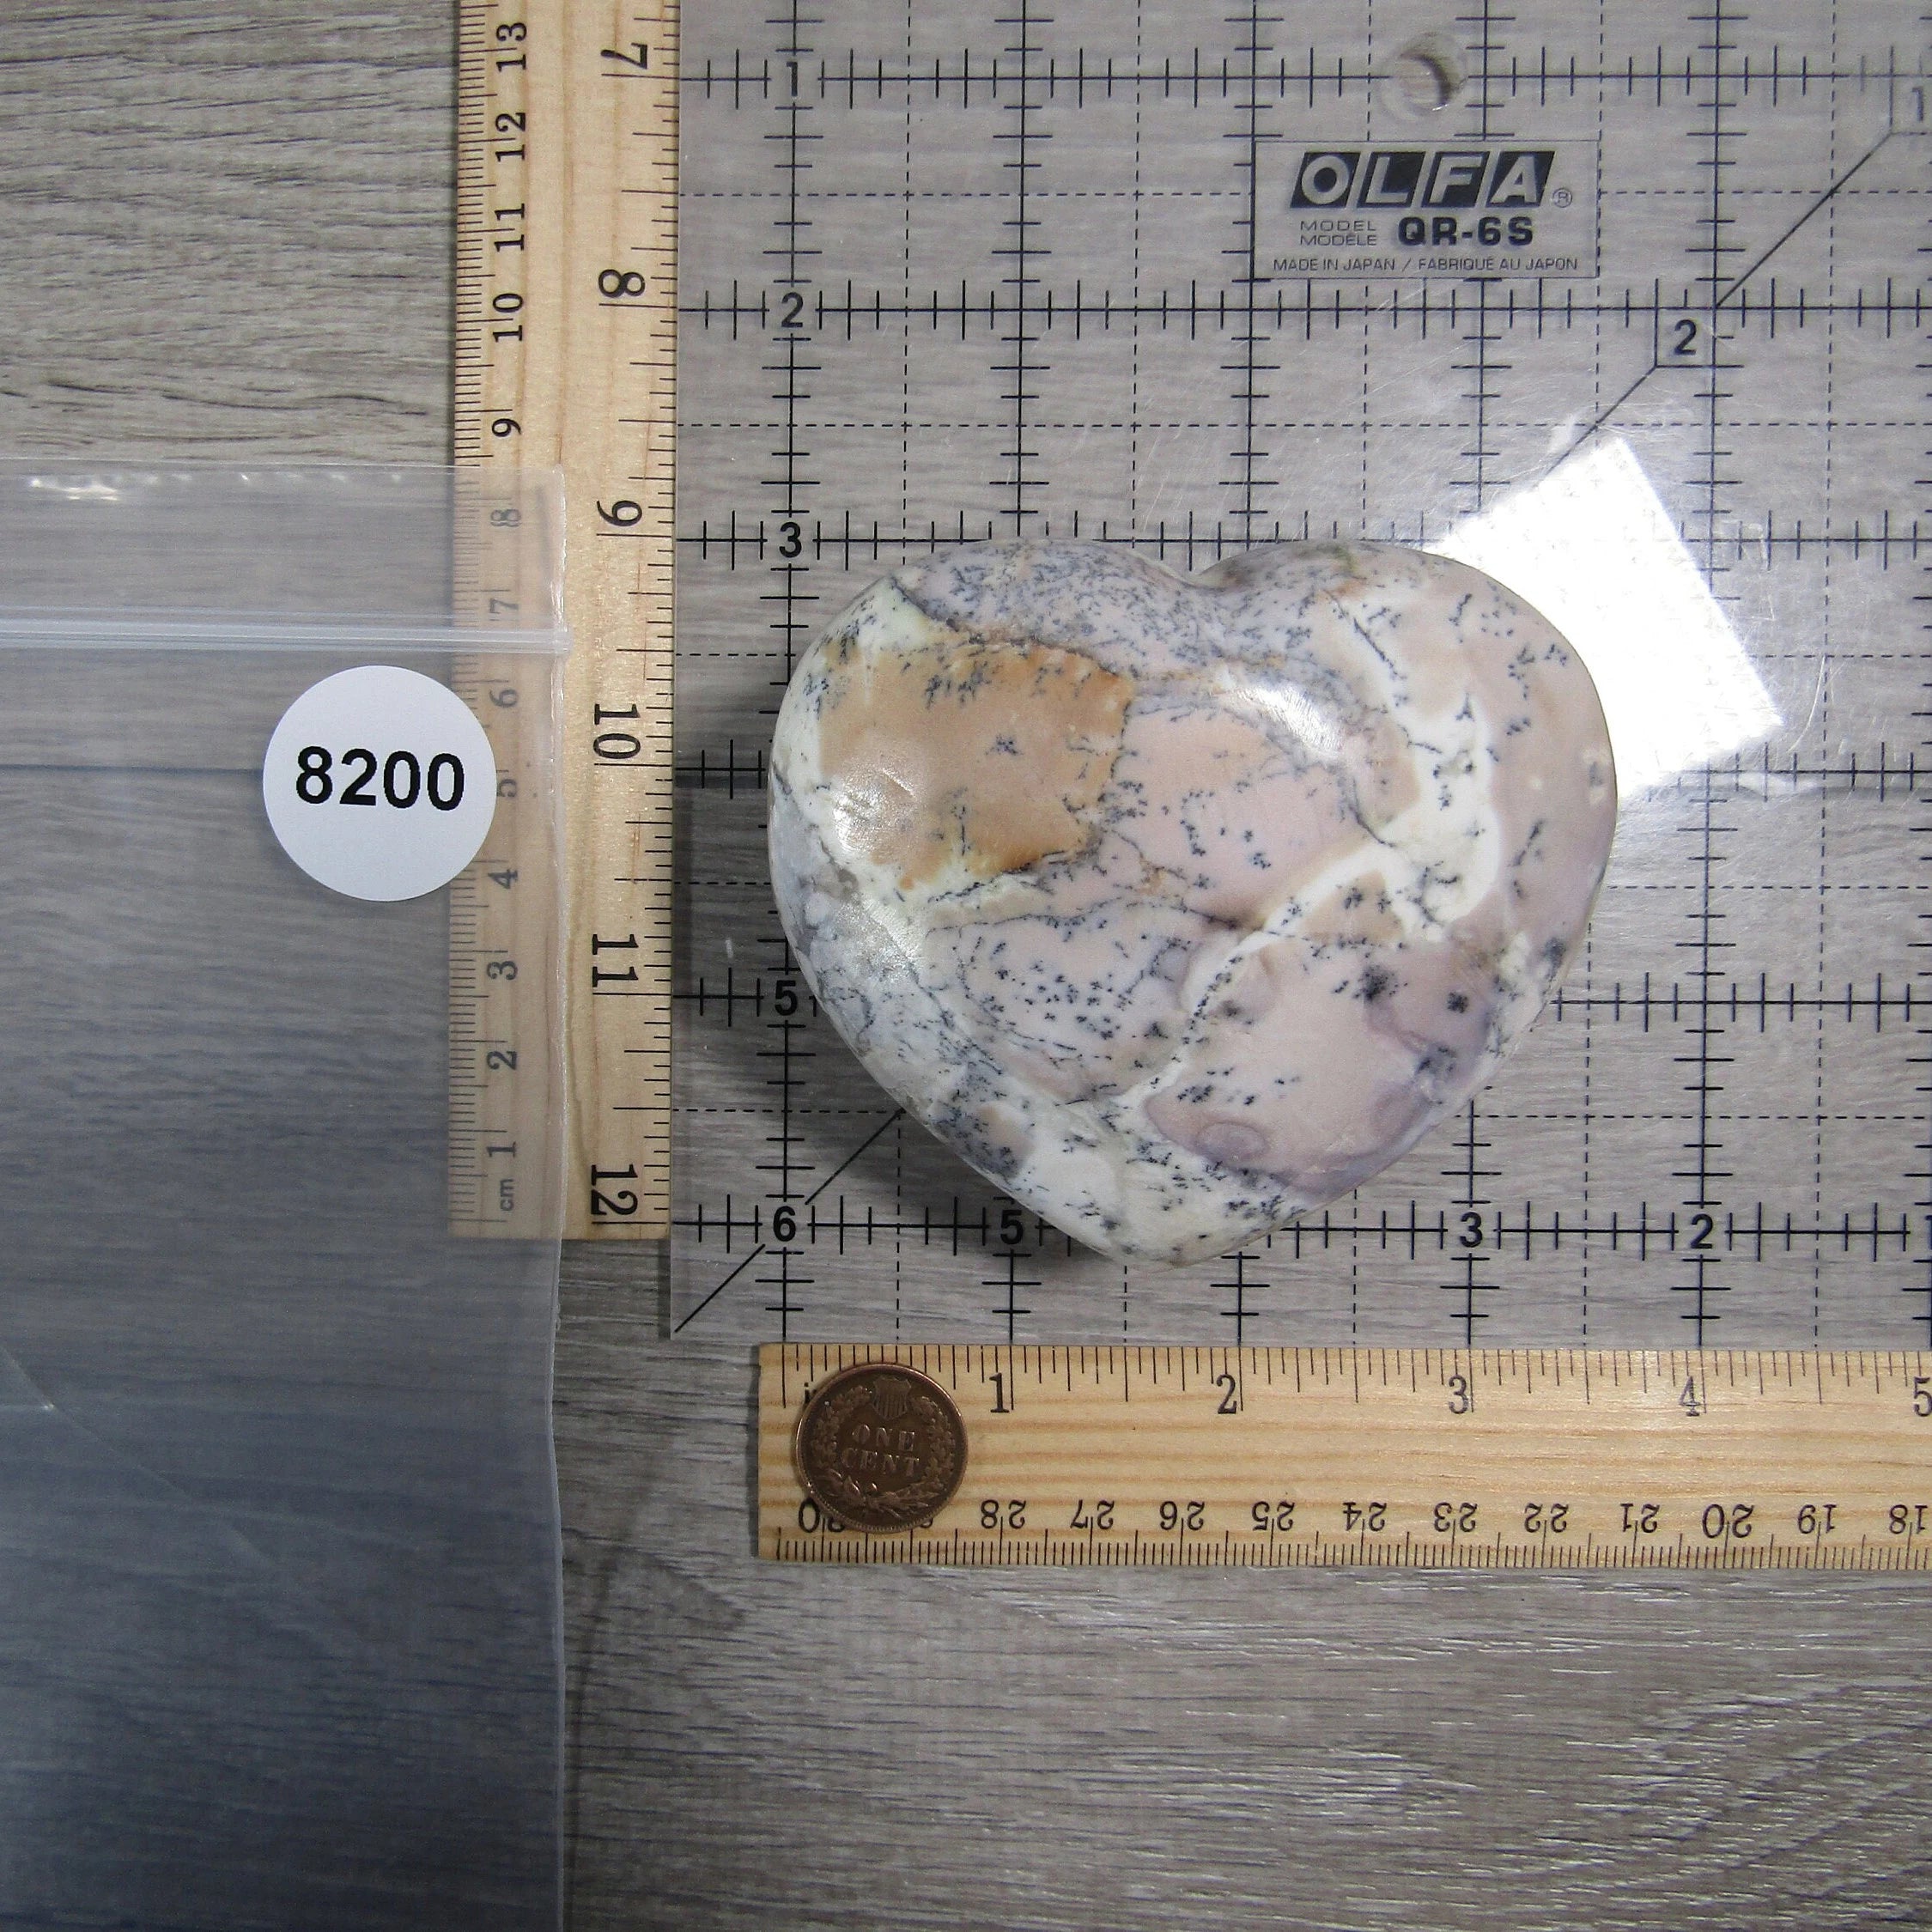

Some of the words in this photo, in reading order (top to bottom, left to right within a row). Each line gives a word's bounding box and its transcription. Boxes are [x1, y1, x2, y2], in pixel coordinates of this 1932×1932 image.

[495, 22, 527, 72] 13
[600, 42, 648, 70] 7
[786, 61, 799, 97] 1
[495, 112, 526, 162] 12
[1291, 152, 1555, 208] OLFA
[494, 203, 526, 252] 11
[1300, 220, 1376, 232] MODEL
[1398, 216, 1534, 246] QR-6S
[1273, 258, 1318, 271] MADE
[1323, 258, 1338, 271] IN
[1343, 258, 1395, 271] JAPAN
[1499, 258, 1521, 270] AU
[1525, 258, 1578, 270] JAPON
[598, 268, 646, 299] 8
[492, 293, 524, 343] 10
[781, 292, 804, 328] 2
[1674, 319, 1697, 355] 2
[491, 417, 522, 438] 9
[489, 507, 522, 528] 8
[596, 499, 642, 527] 9
[778, 521, 803, 558] 3
[489, 598, 519, 623] 7
[489, 688, 519, 708] 6
[592, 702, 642, 761] 10
[295, 745, 465, 811] 8200
[488, 867, 519, 890] 4
[486, 960, 519, 981] 3
[592, 933, 639, 988] 11
[775, 980, 798, 1016] 5
[486, 1049, 518, 1071] 2
[486, 1141, 517, 1158] 1
[499, 1179, 514, 1212] cm
[590, 1163, 639, 1216] 12
[773, 1206, 797, 1242] 6
[999, 1209, 1024, 1244] 5
[1459, 1212, 1483, 1249] 3
[1690, 1213, 1714, 1249] 2
[989, 1372, 1009, 1413] 1
[1216, 1374, 1237, 1415] 2
[1448, 1374, 1469, 1415] 3
[1678, 1375, 1701, 1417] 4
[1913, 1376, 1932, 1417] 5
[852, 1424, 916, 1452] ONE
[841, 1447, 920, 1476] CENT
[981, 1499, 1027, 1529] 28
[1070, 1499, 1115, 1529] 27
[1159, 1500, 1205, 1531] 26
[1251, 1501, 1295, 1532] 25
[1342, 1502, 1387, 1532] 24
[1433, 1502, 1478, 1534] 23
[1524, 1503, 1569, 1534] 22
[1620, 1503, 1661, 1534] 21
[1702, 1503, 1755, 1539] 20
[1797, 1504, 1838, 1534] 19
[1889, 1504, 1929, 1534] 18
